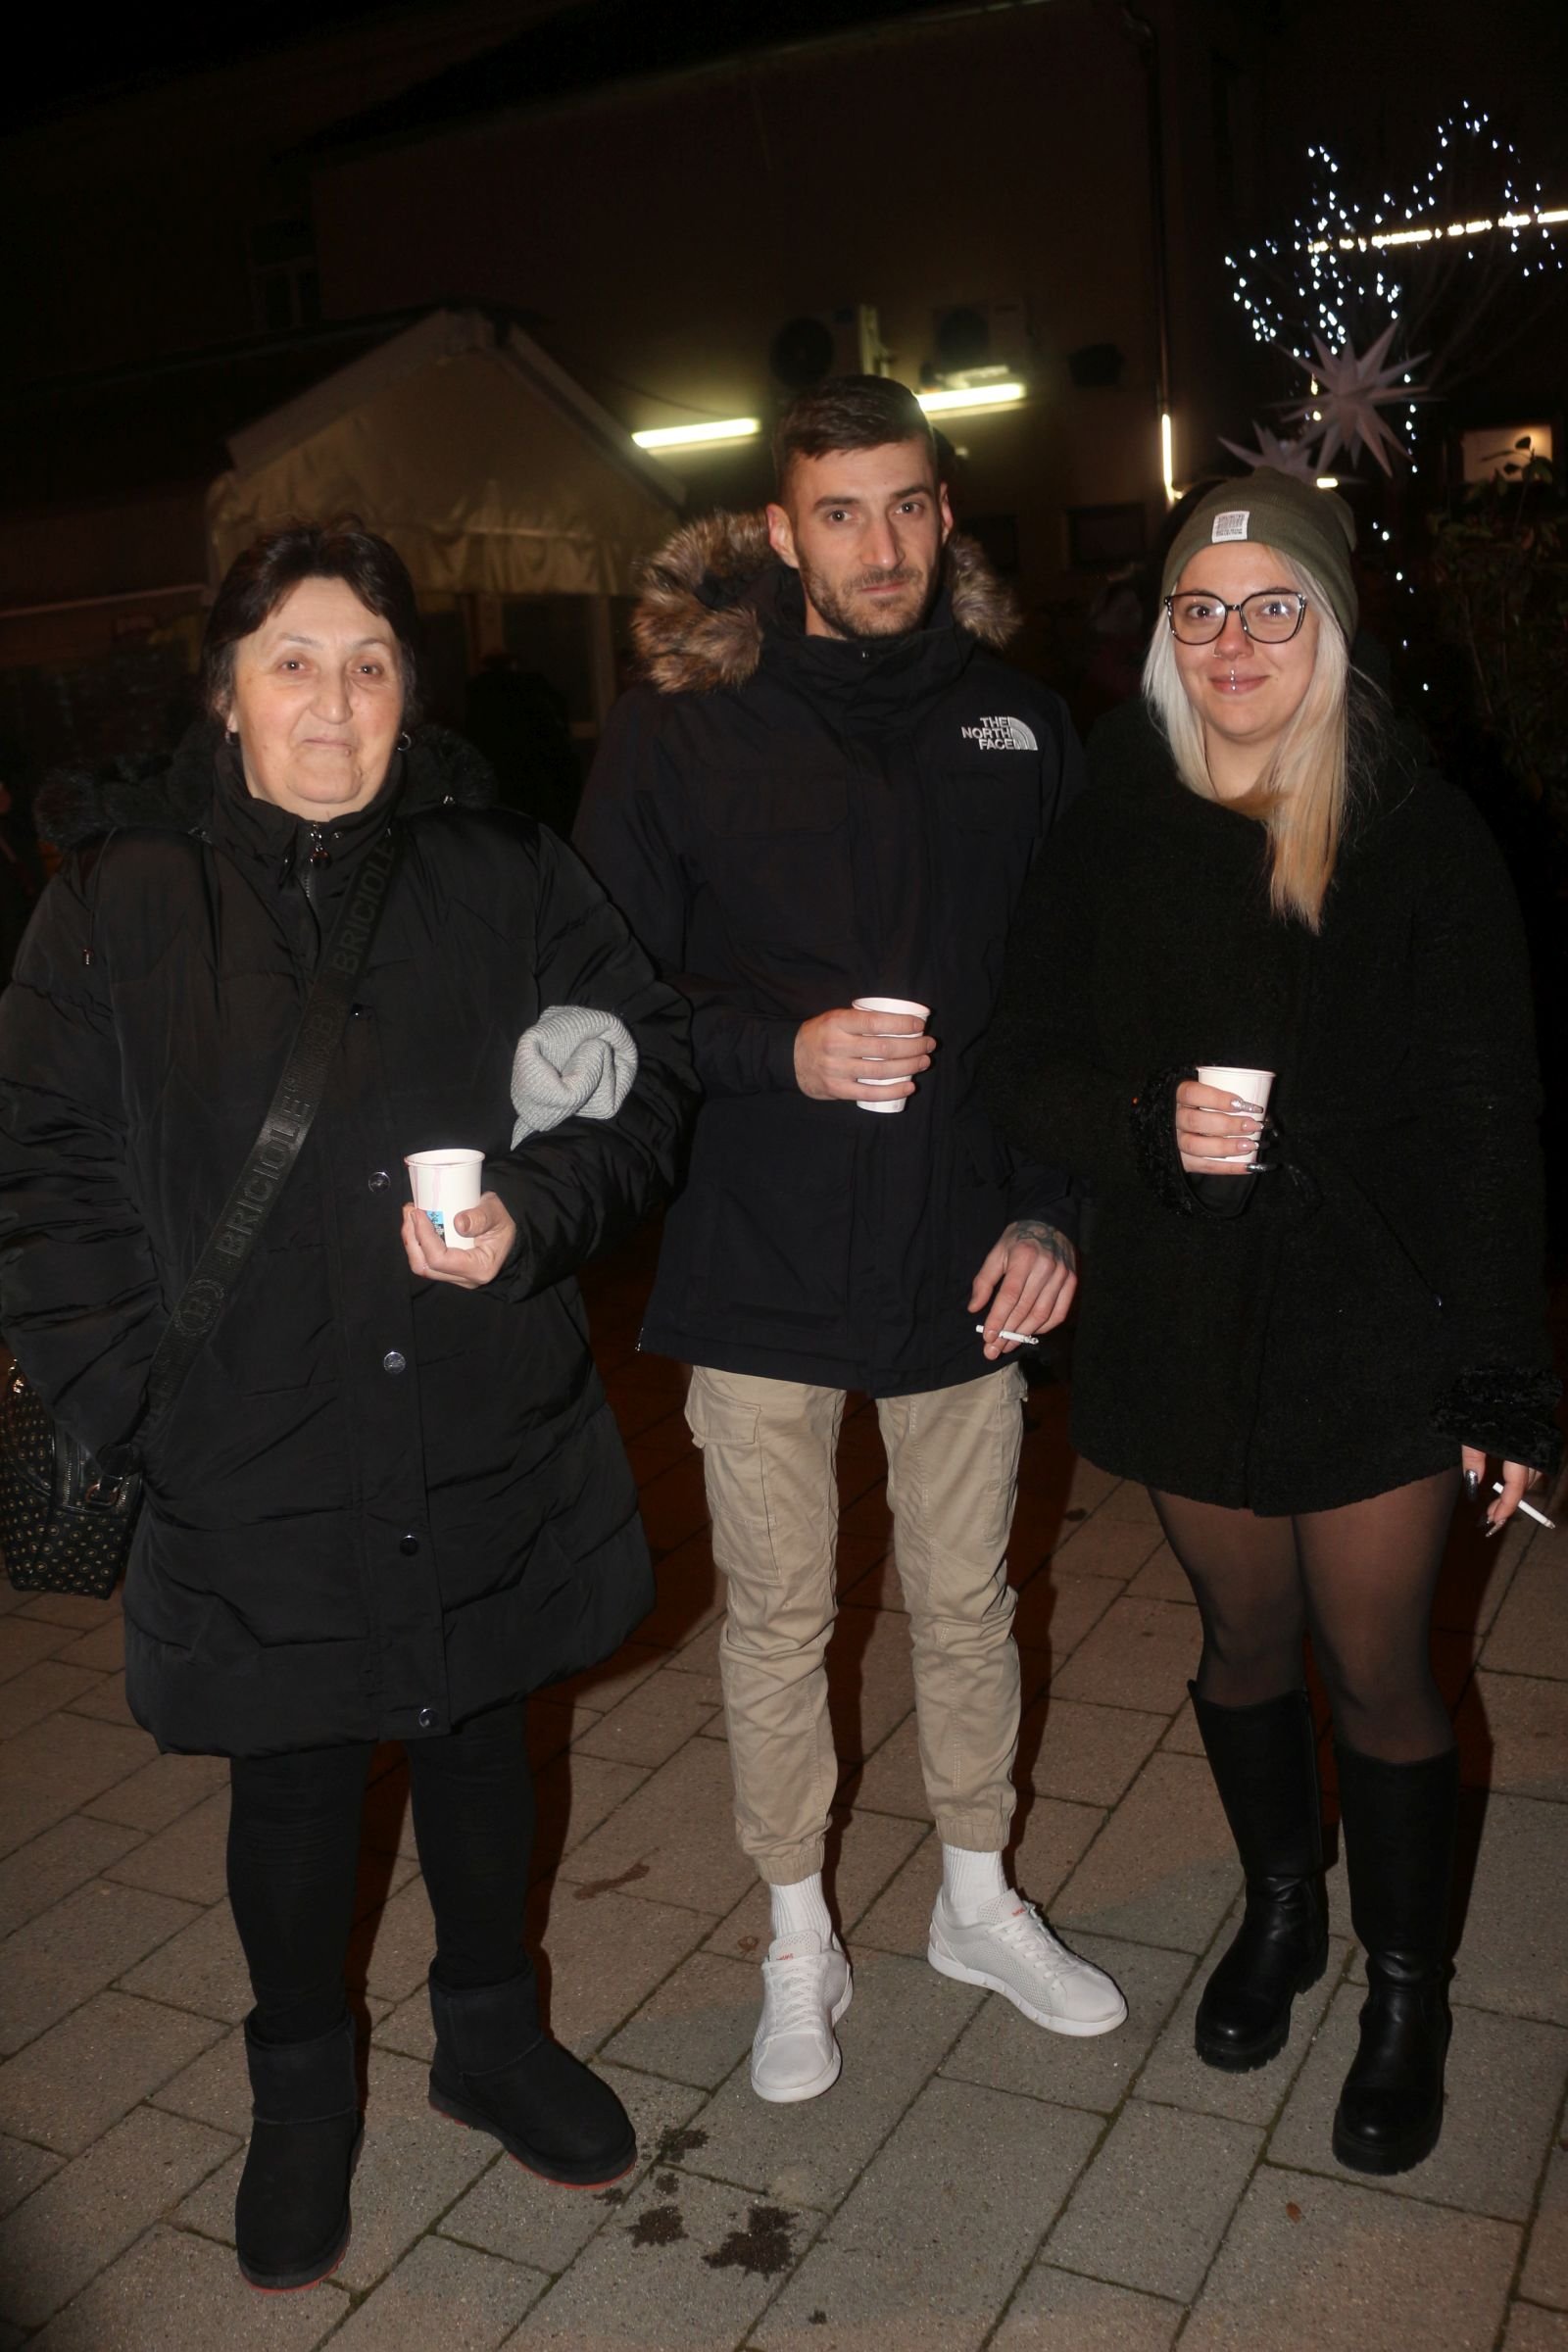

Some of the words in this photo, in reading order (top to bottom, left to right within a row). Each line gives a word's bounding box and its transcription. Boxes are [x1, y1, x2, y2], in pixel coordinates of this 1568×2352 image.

[979, 715, 1008, 728] THE
[960, 726, 1011, 739] NORTH
[978, 738, 1014, 751] FACE
